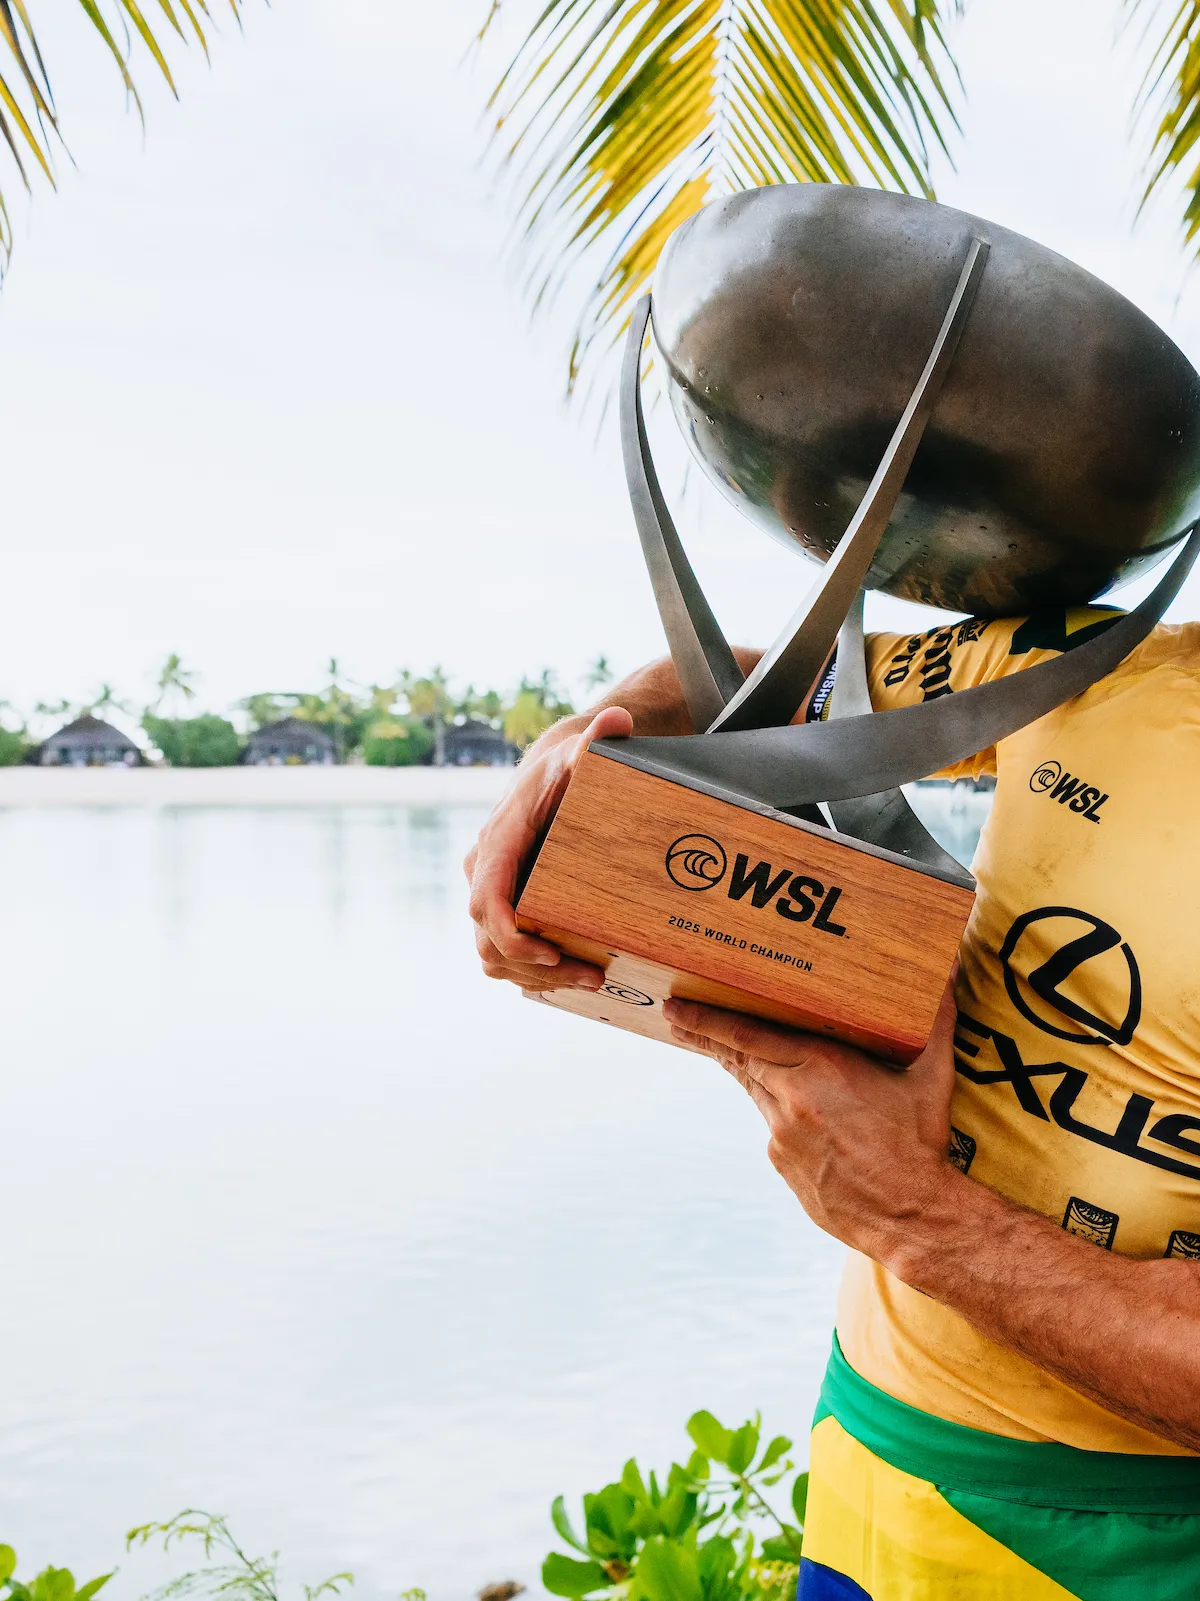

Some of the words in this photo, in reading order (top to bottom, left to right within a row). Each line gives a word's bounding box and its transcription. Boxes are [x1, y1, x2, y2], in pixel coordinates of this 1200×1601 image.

[1049, 773, 1110, 823] WSL
[727, 852, 849, 937] WSL
[668, 915, 701, 933] 2025
[704, 927, 747, 949] WORLD
[750, 943, 813, 972] CHAMPION
